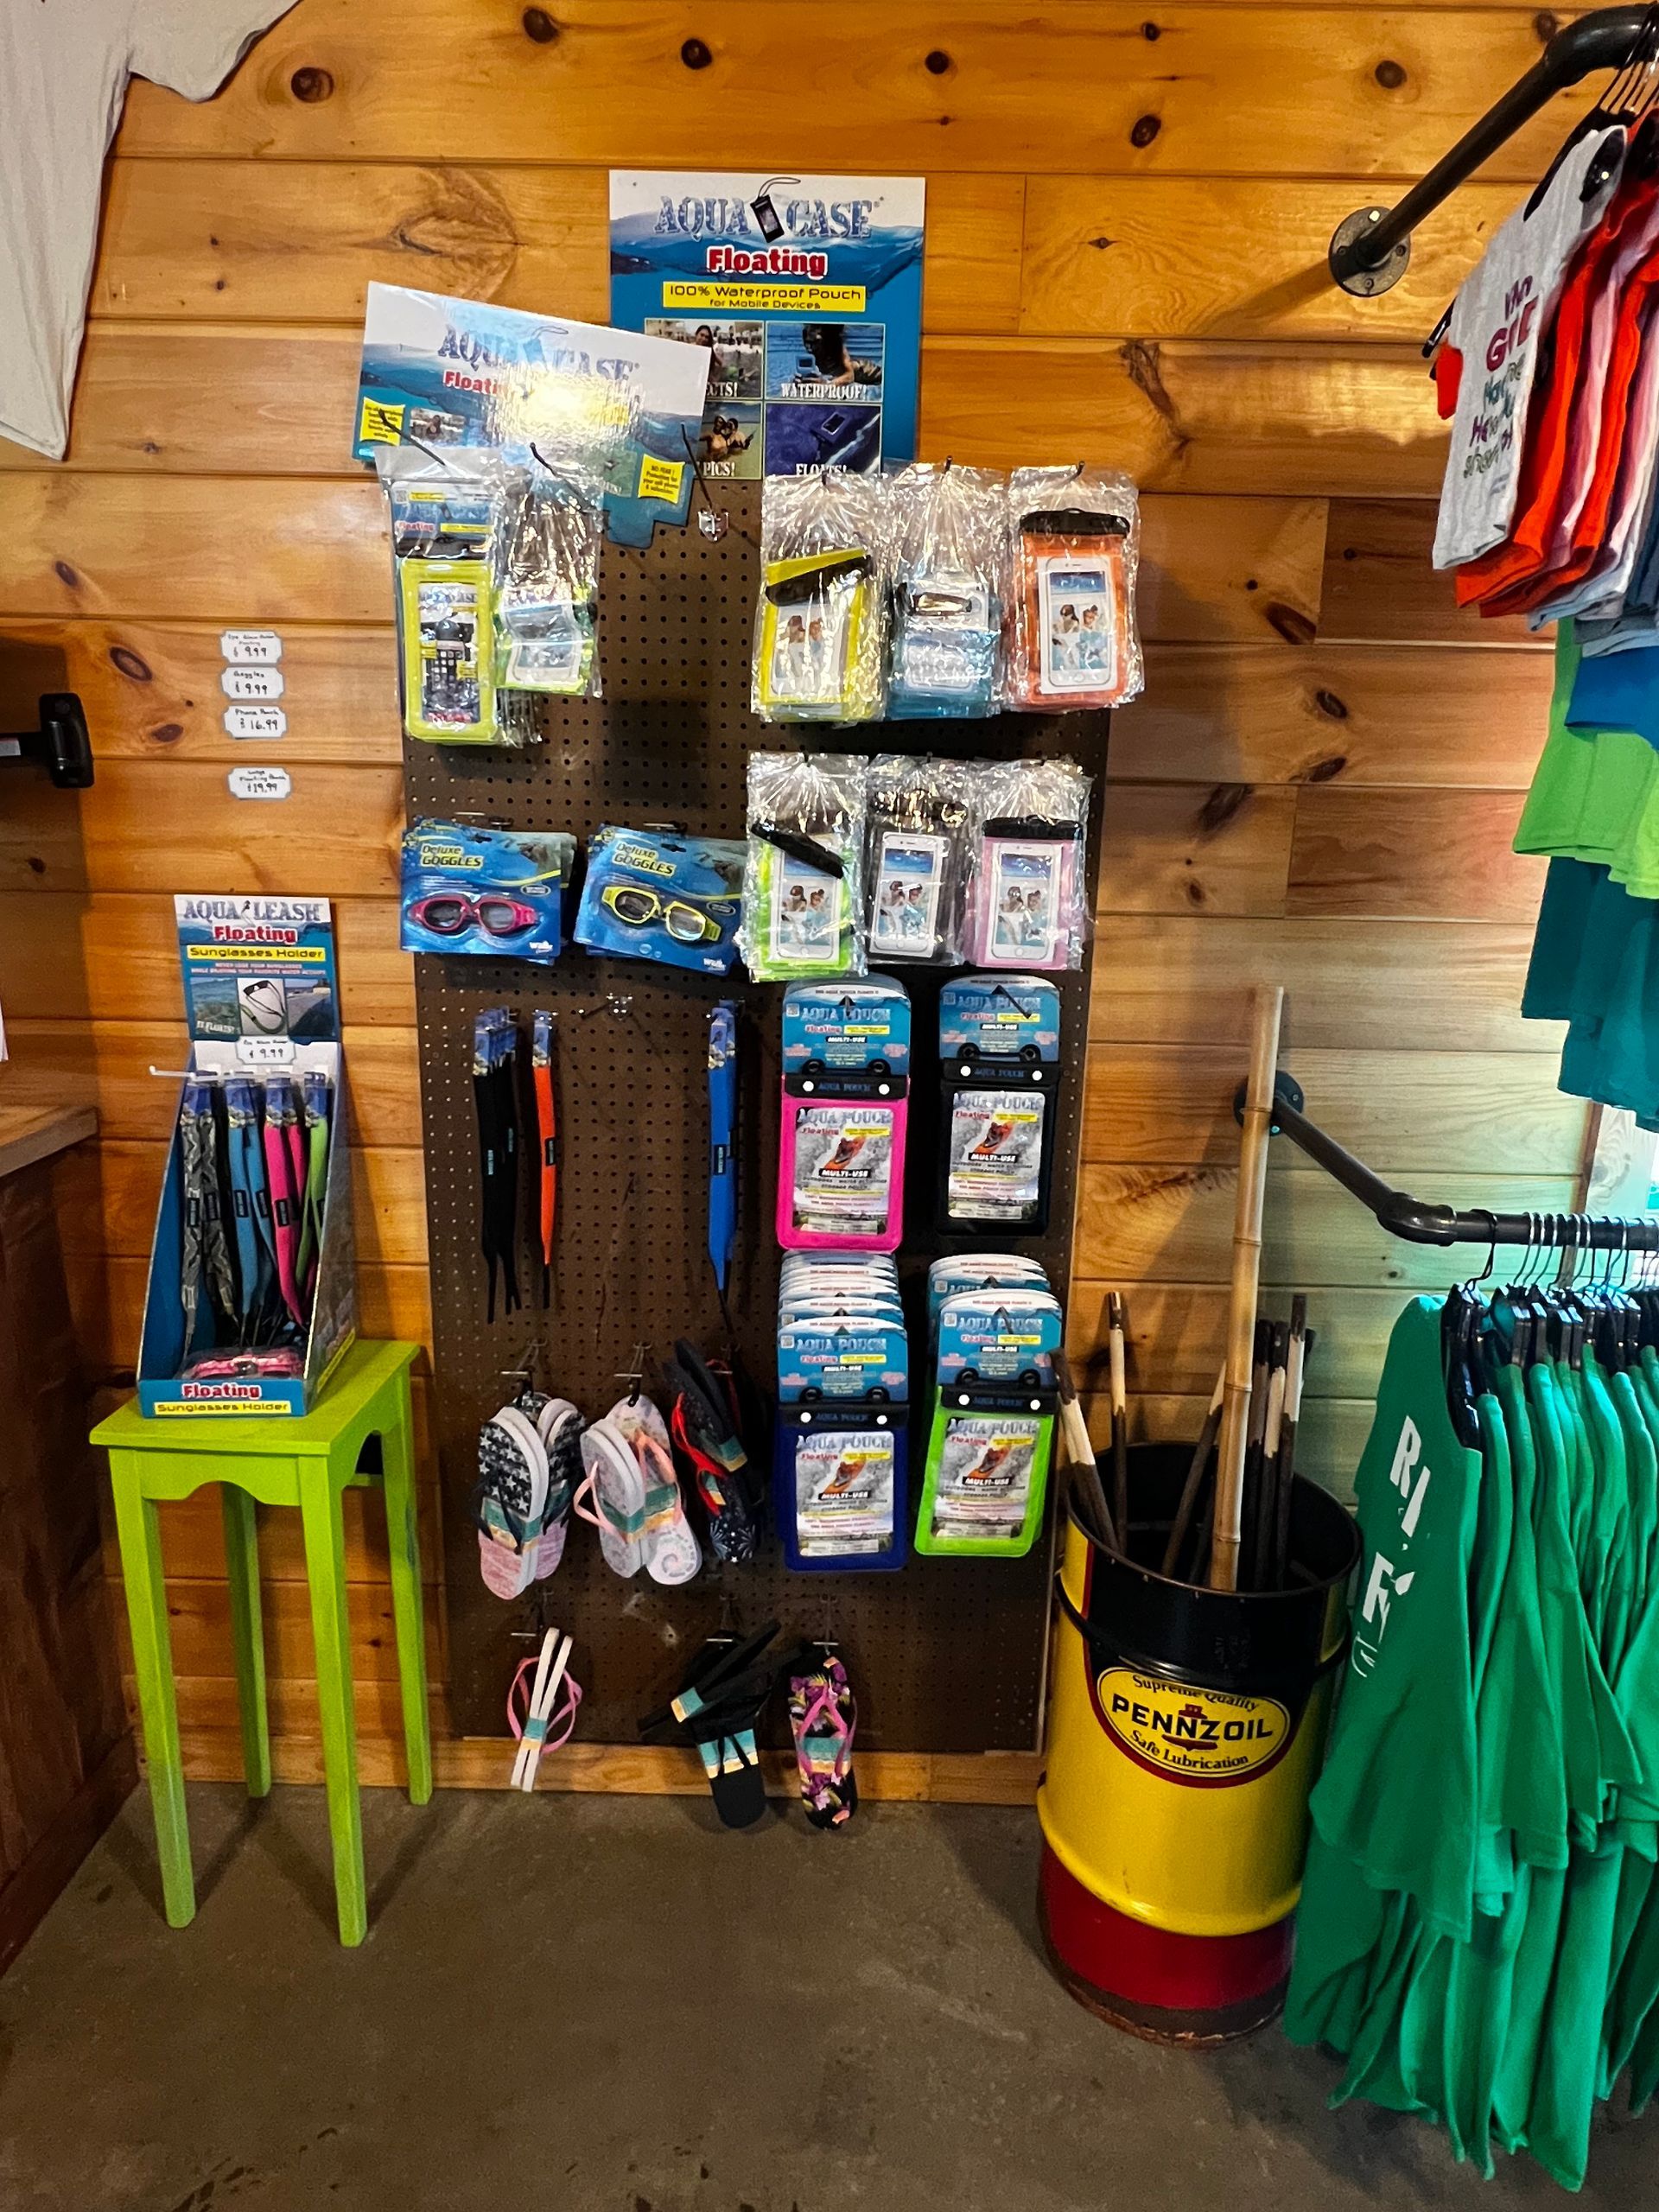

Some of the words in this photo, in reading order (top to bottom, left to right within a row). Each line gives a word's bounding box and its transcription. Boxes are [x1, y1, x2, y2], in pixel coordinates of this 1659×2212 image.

[654, 195, 751, 242] AQUA
[786, 198, 873, 238] CASE
[707, 247, 828, 280] Floating
[670, 285, 709, 296] 100%
[715, 286, 804, 298] Waterproof
[809, 288, 861, 300] Pouch
[709, 299, 725, 308] for
[729, 300, 769, 308] Mobile
[772, 300, 821, 309] Devices
[781, 382, 867, 399] WATERPROOF!
[422, 844, 461, 854] Deluxe
[616, 843, 656, 858] Deluxe
[422, 855, 481, 867] GOGGLES
[614, 853, 674, 874] GOGGLES
[183, 899, 241, 923] AQUA
[253, 900, 323, 922] LEASH
[213, 925, 297, 944] Floating
[189, 947, 272, 958] Sunglasses
[276, 949, 323, 959] Holder
[801, 1007, 839, 1021] AQUA
[804, 1025, 842, 1034] Floating
[955, 1110, 990, 1120] Floating
[970, 1154, 1016, 1162] MULTI-USE
[821, 1169, 868, 1178] MULTI-USE
[957, 1316, 994, 1332] AQUA
[796, 1338, 832, 1354] AQUA
[838, 1338, 887, 1351] POUCH
[182, 1383, 261, 1399] Floating
[157, 1403, 238, 1412] Sunglasses
[243, 1402, 288, 1411] Holder
[796, 1434, 837, 1452] AQUA
[841, 1435, 892, 1449] POUCH
[965, 1478, 1010, 1486] MULTI-USE
[1132, 1675, 1203, 1699] Supreme
[1202, 1691, 1260, 1713] Quality
[1111, 1693, 1274, 1742] PENNZOIL
[1130, 1729, 1160, 1757] Safe
[1164, 1748, 1249, 1770] Lubrication
